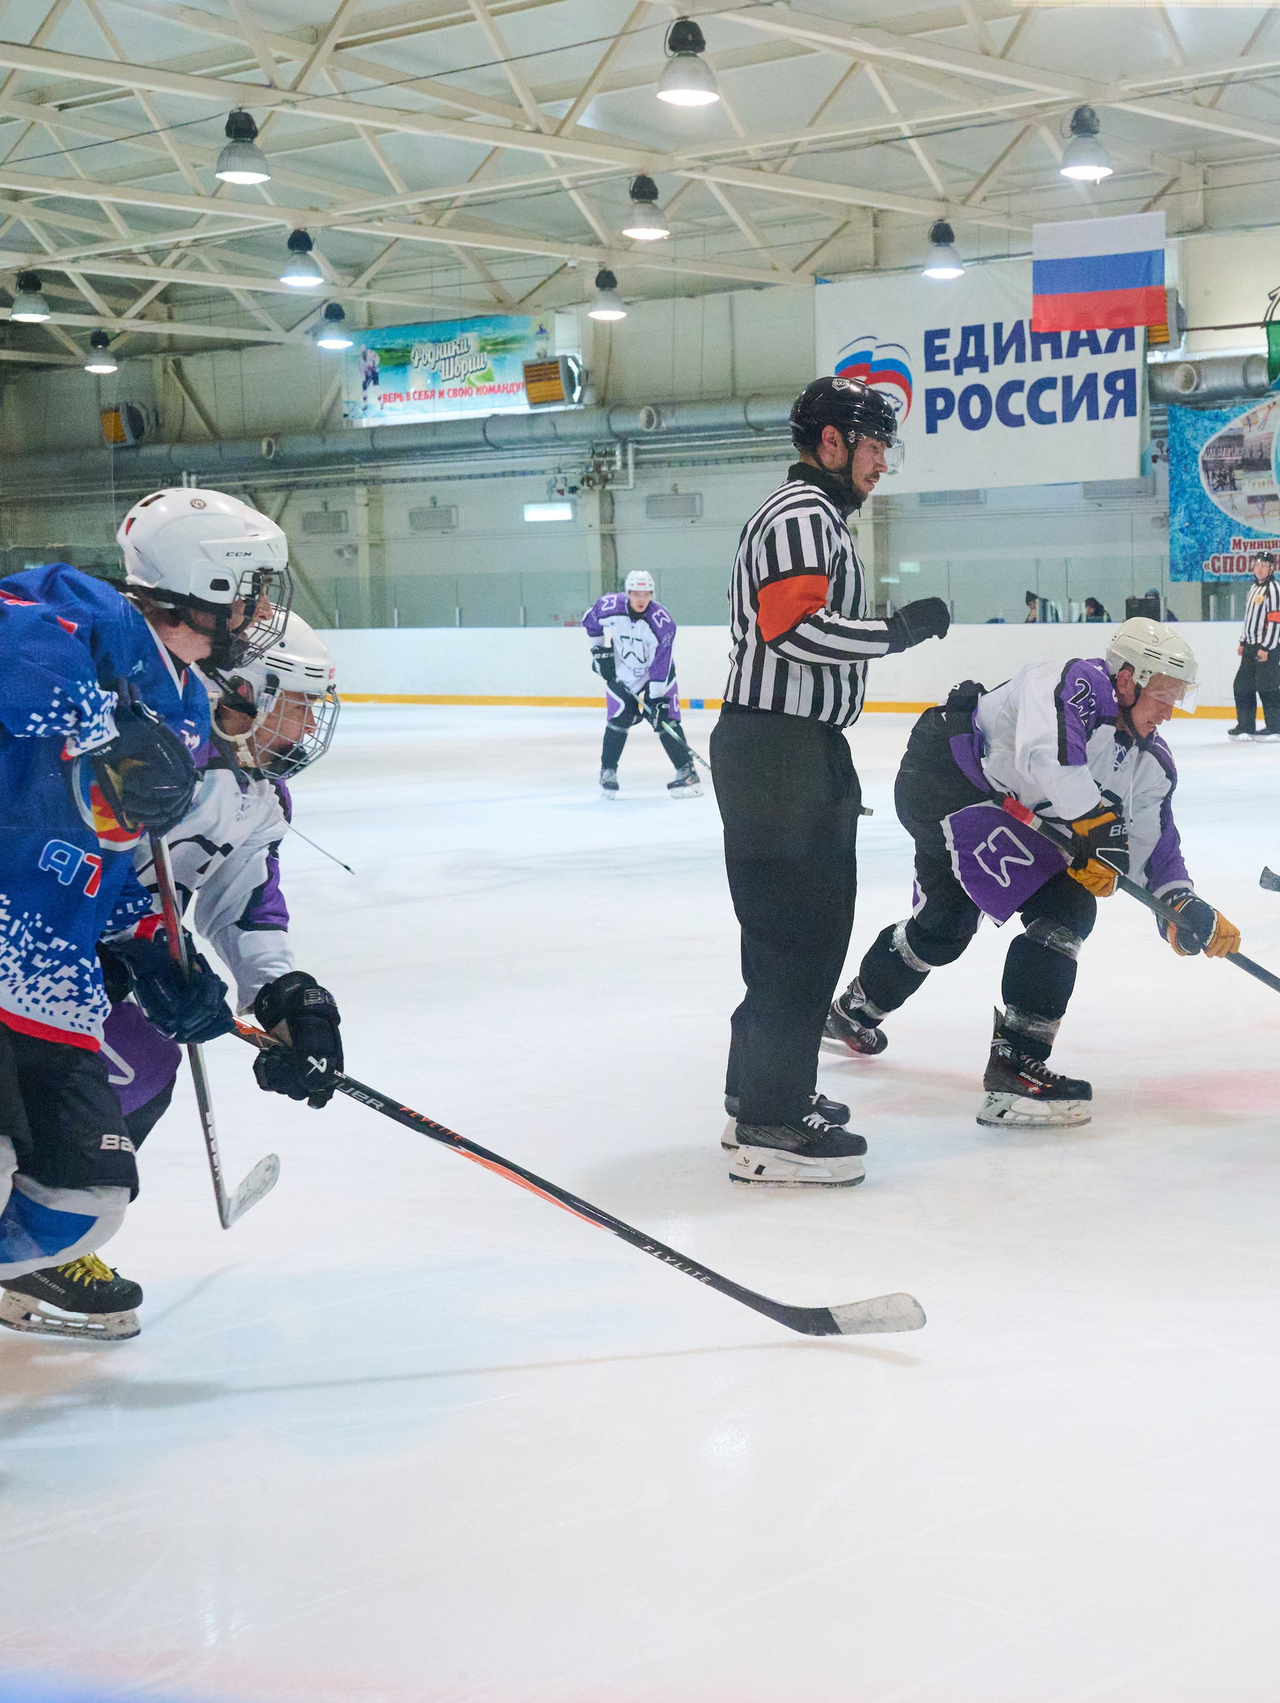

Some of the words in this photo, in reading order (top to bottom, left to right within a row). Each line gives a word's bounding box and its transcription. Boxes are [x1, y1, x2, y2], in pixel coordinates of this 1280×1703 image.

[923, 317, 1136, 376] ЕДИНАЯ
[382, 393, 403, 404] ВЕРЬ
[412, 389, 436, 401] СЕБЯ
[438, 389, 445, 399] И
[447, 386, 474, 398] СВОЮ
[924, 368, 1137, 434] РОССИЯ
[642, 1244, 712, 1284] FLYLITE
